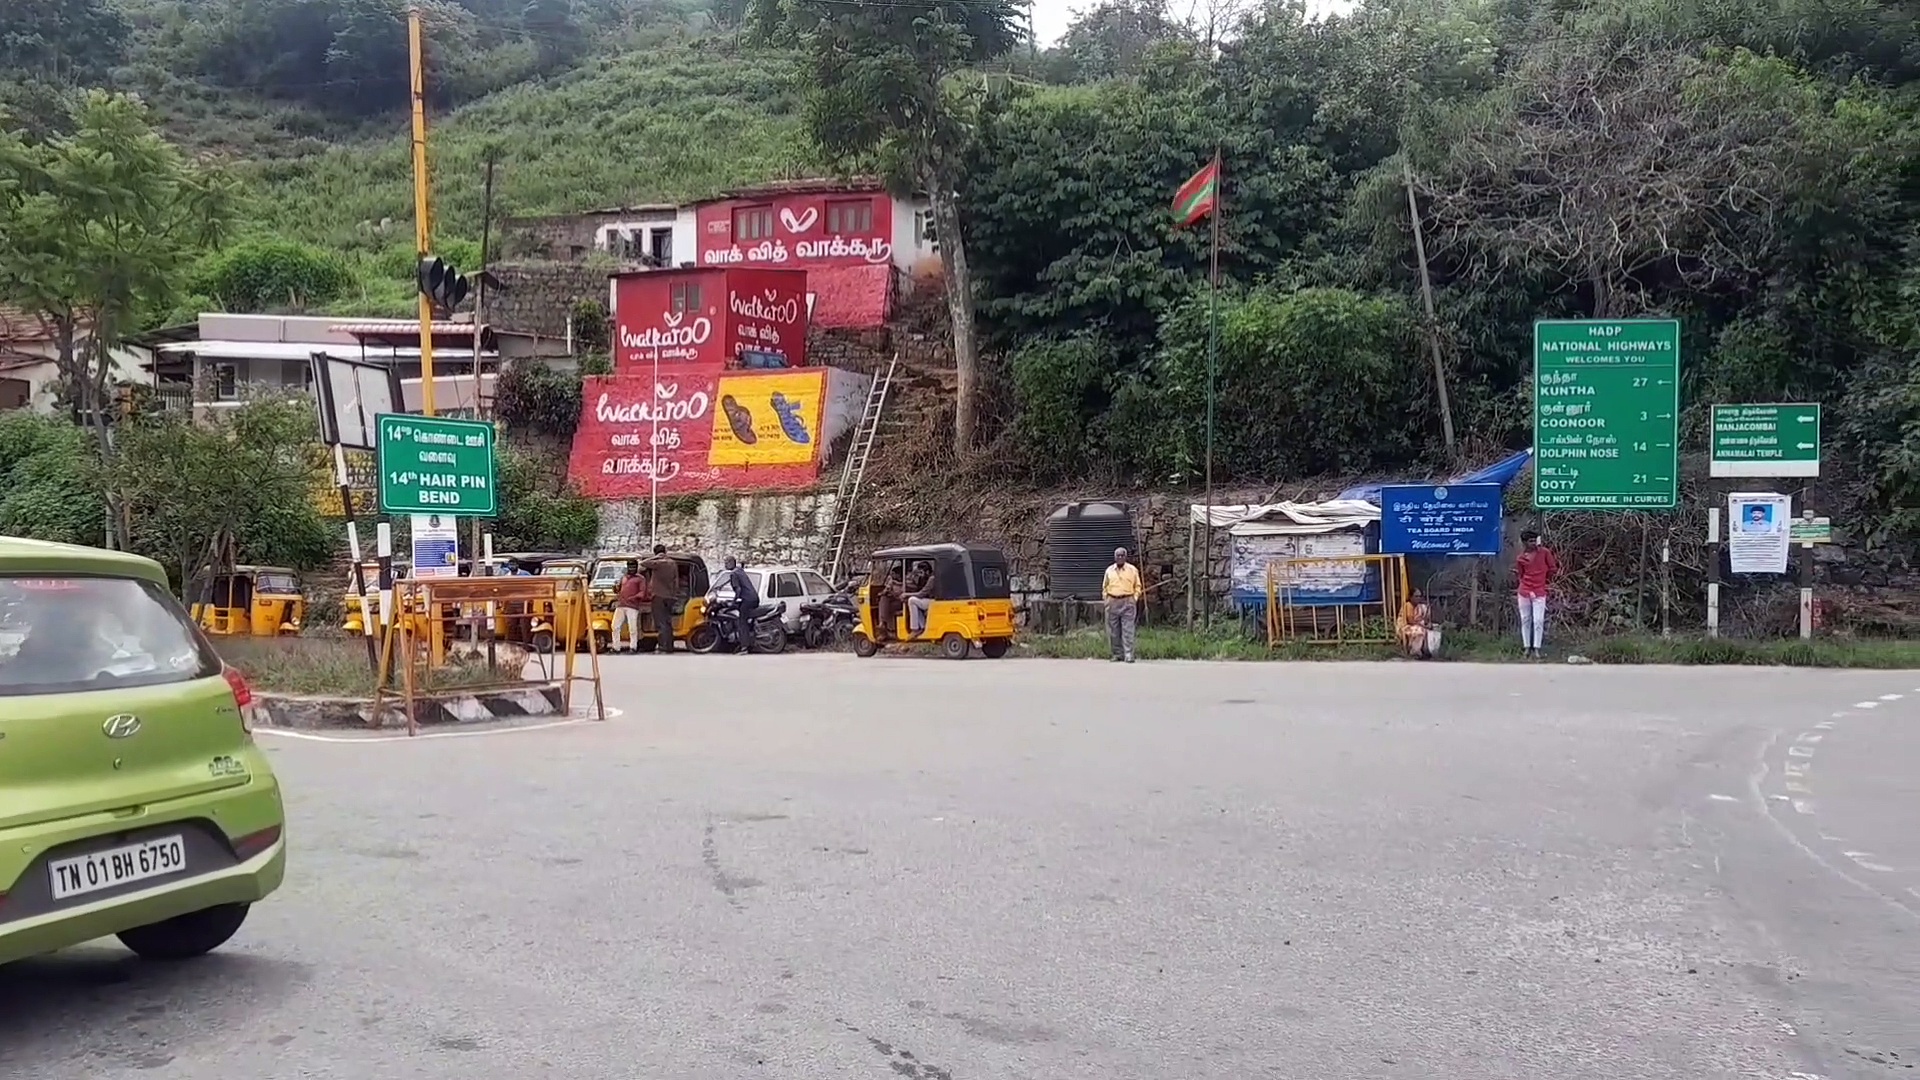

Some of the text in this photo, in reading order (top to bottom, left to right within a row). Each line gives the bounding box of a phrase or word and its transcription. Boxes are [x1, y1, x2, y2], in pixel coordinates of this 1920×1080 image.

[704, 243, 743, 264] வாக்
[748, 239, 788, 263] வித்
[1588, 326, 1622, 337] HADP
[1542, 340, 1672, 352] NATIONAL HIGHWAYS
[1565, 355, 1645, 364] WELCOMES YOU
[1540, 370, 1578, 385] குந்தா
[1632, 377, 1648, 387] 27
[1540, 385, 1596, 396] KUNTHA
[1540, 400, 1592, 416] குன்னூர்
[1640, 411, 1648, 421] 3
[1540, 418, 1606, 428] COONOOR
[1715, 422, 1776, 431] MANJACOMBAI
[611, 428, 641, 446] வாக்
[1632, 441, 1647, 452] 14
[1540, 448, 1620, 458] DOLPHIN NOSE
[1540, 463, 1579, 479] ஊட்டி
[389, 471, 486, 489] 14th HAIR PIN
[1632, 474, 1647, 484] 21
[1540, 480, 1577, 490] OOTY
[418, 490, 461, 504] BEND
[1538, 495, 1669, 503] DO NOT OVERTAKE IN CURVES
[1411, 538, 1470, 551] Welcomes You
[57, 842, 181, 892] TN 01 BH 6750
